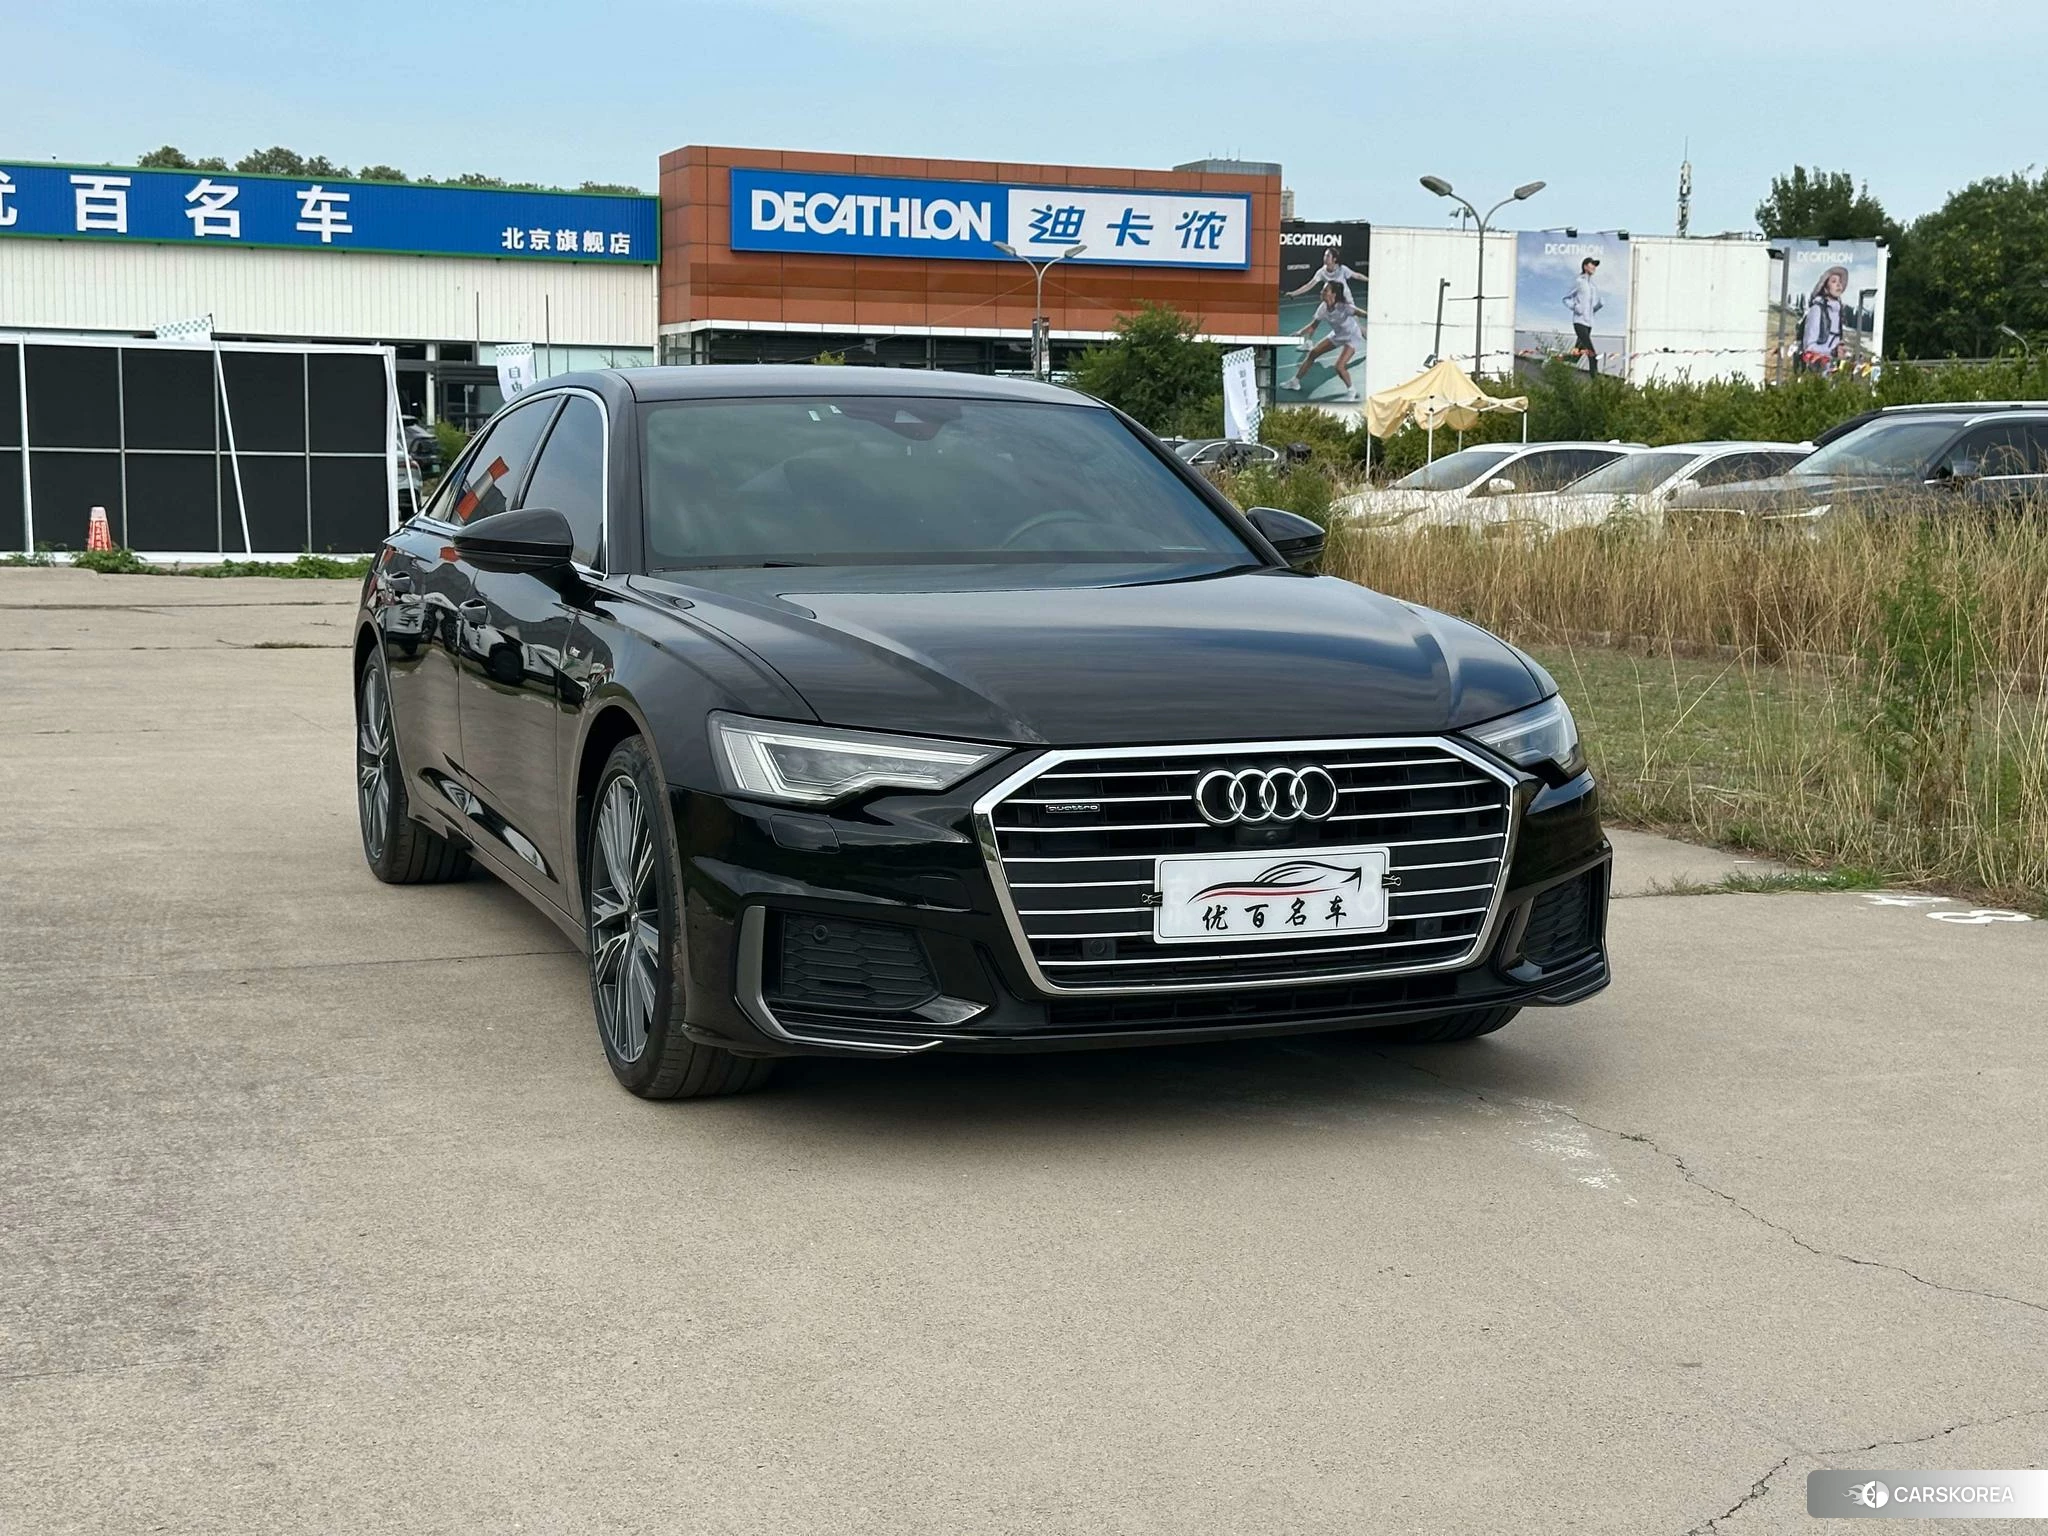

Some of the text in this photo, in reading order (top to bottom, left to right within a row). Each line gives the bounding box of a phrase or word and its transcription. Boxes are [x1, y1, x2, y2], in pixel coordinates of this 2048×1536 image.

[751, 188, 992, 242] DECATHLON
[1028, 204, 1227, 250] 迪卡侬
[501, 227, 631, 255] 北京旗舰店
[1280, 233, 1342, 247] DECATHLON
[1544, 243, 1604, 256] DECATHLON
[1797, 251, 1854, 264] DECATHLON
[1048, 804, 1098, 812] quattro
[1202, 895, 1348, 931] 优百名车
